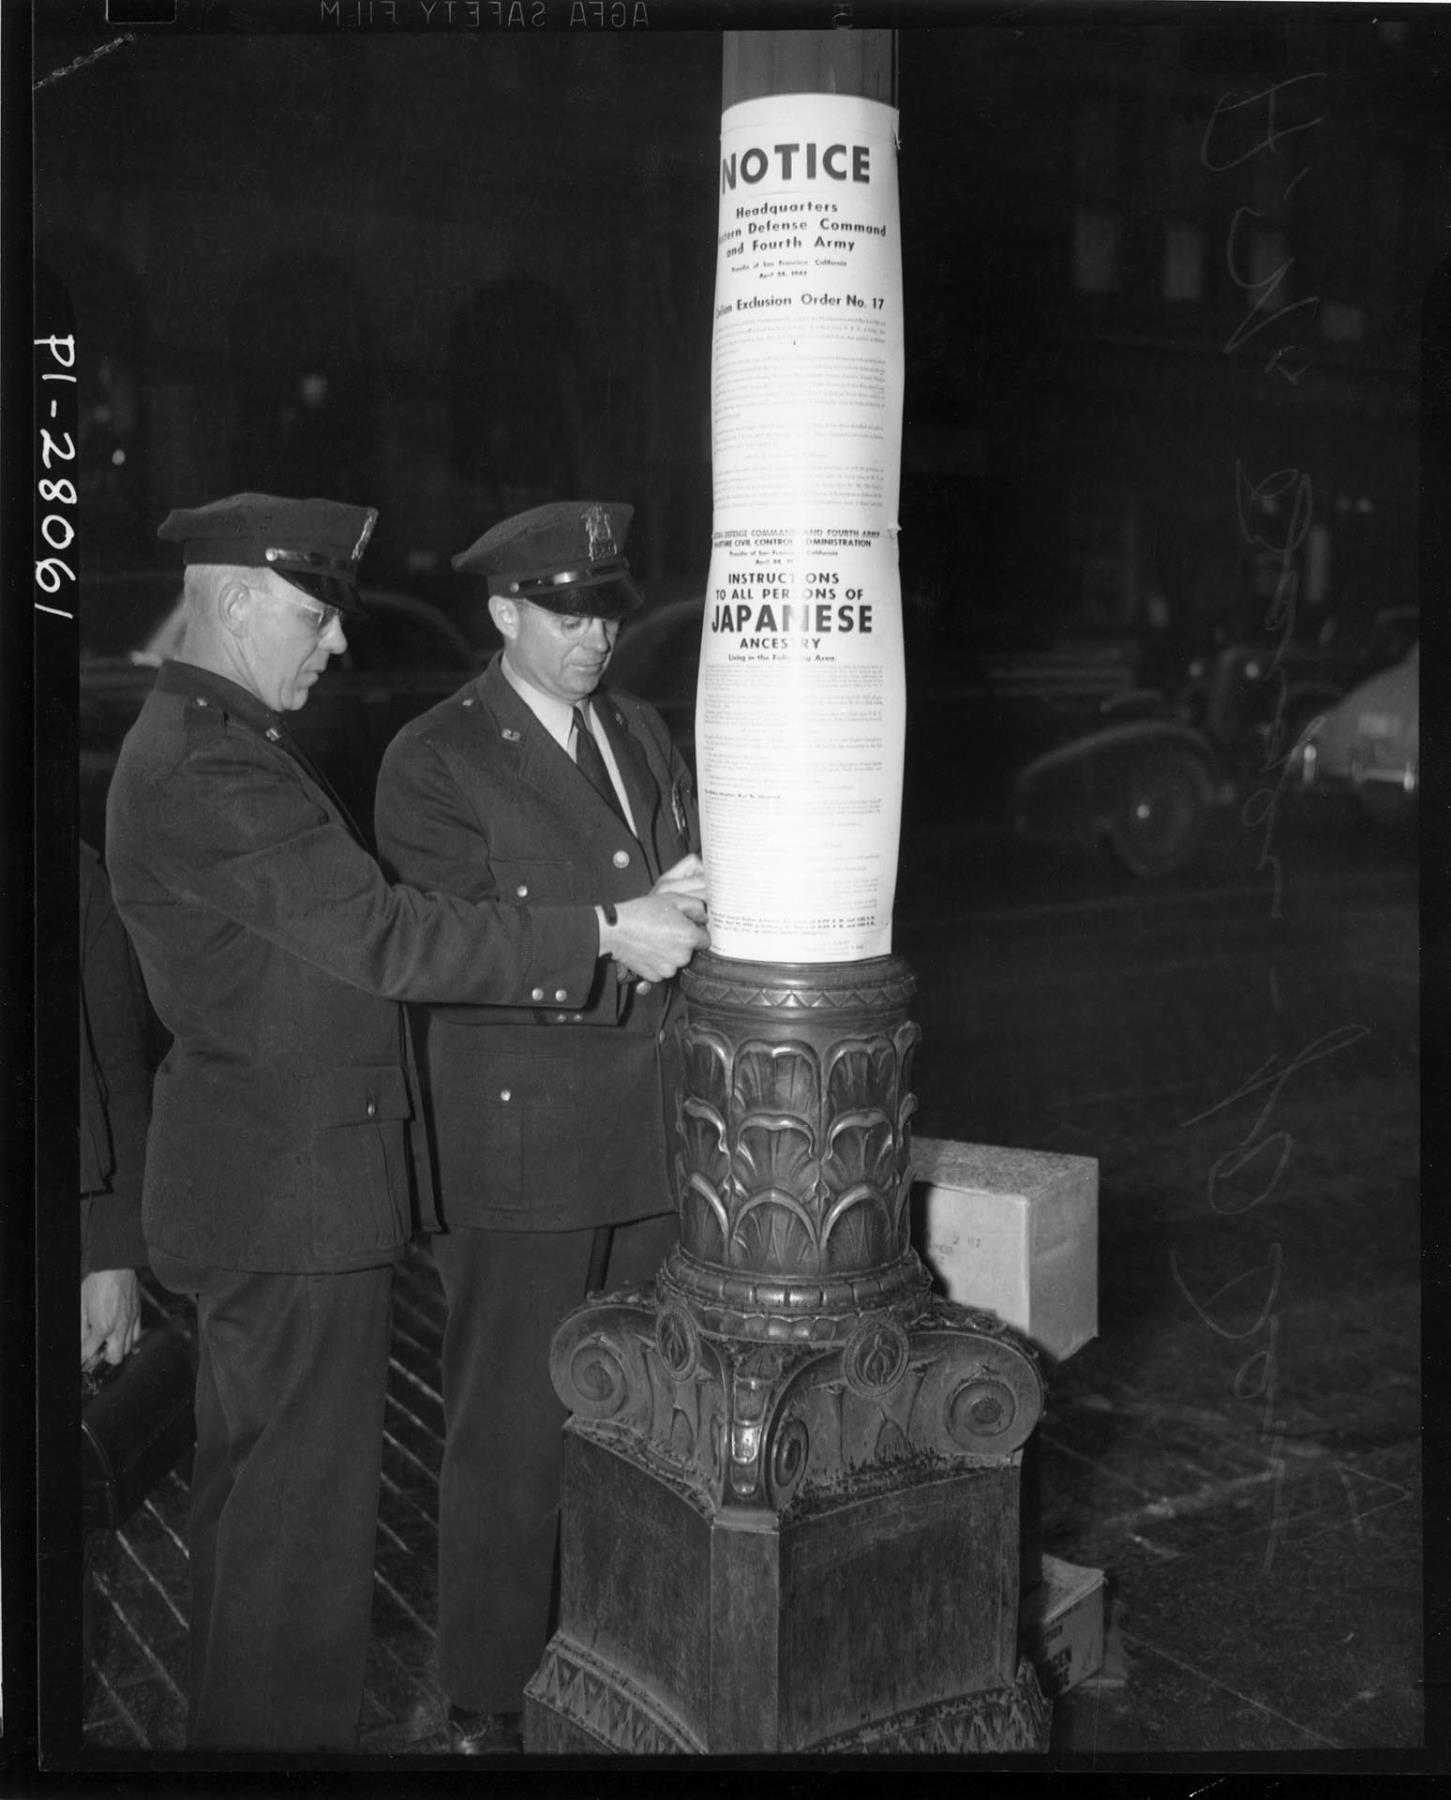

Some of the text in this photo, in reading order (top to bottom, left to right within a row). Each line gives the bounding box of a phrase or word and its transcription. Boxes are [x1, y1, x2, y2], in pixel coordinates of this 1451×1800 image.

[722, 143, 870, 194] NOTICE
[736, 202, 839, 219] Headquarters
[748, 219, 808, 234] Defense
[820, 218, 887, 237] Command
[726, 236, 856, 258] and Fourth Army
[736, 293, 792, 311] Exclusion
[801, 292, 842, 306] Order
[872, 297, 886, 311] 17
[728, 573, 840, 584] INSTRUCTONS
[716, 588, 864, 601] TO ALL PERONS OF
[712, 604, 873, 634] JAPANESE
[739, 637, 821, 649] ANCESRY
[757, 654, 769, 662] the
